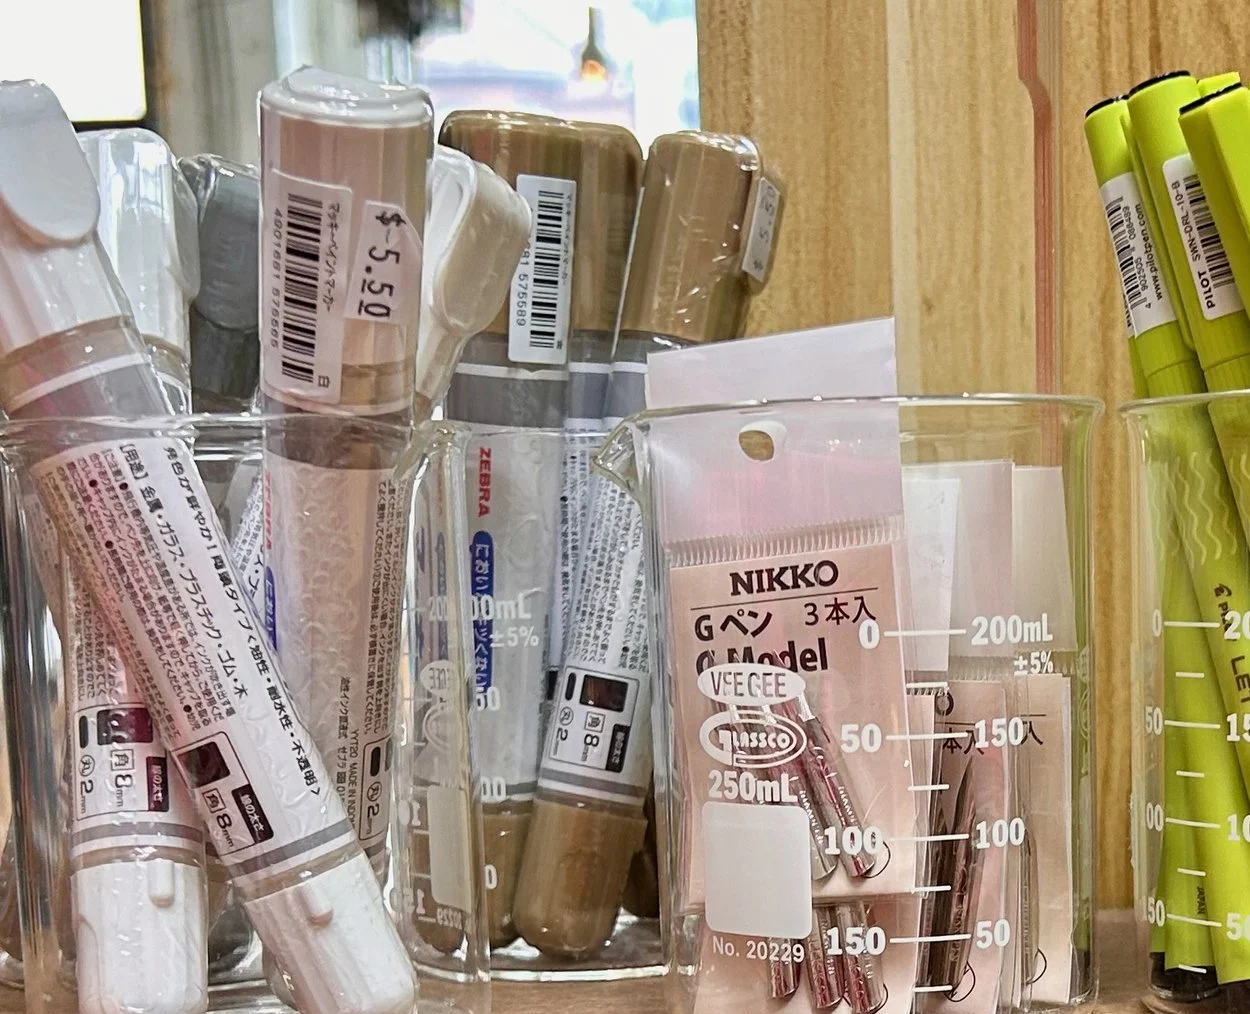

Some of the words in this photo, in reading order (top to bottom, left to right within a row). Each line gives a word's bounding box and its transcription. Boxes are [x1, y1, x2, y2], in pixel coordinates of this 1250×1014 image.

[1135, 203, 1163, 301] www.pilotpen.com
[516, 275, 529, 327] 575589
[1198, 270, 1216, 310] PILOT
[477, 447, 492, 518] ZEBRA
[730, 560, 838, 596] NIKKO
[490, 626, 539, 648] ±5%
[858, 618, 880, 650] 0
[971, 613, 1053, 645] 200mL
[1152, 609, 1163, 638] 0
[1013, 650, 1054, 676] ±5%
[839, 725, 882, 753] 50
[974, 717, 1023, 748] 150
[349, 762, 357, 787] MADE
[708, 770, 797, 803] 250mL
[78, 779, 94, 813] 2mm
[823, 826, 883, 856] 100
[975, 818, 1025, 849] 100
[1197, 886, 1206, 915] JAPAN
[713, 937, 739, 958] No.
[745, 941, 805, 963] 20229
[825, 926, 886, 955] 150
[976, 919, 1010, 947] 50
